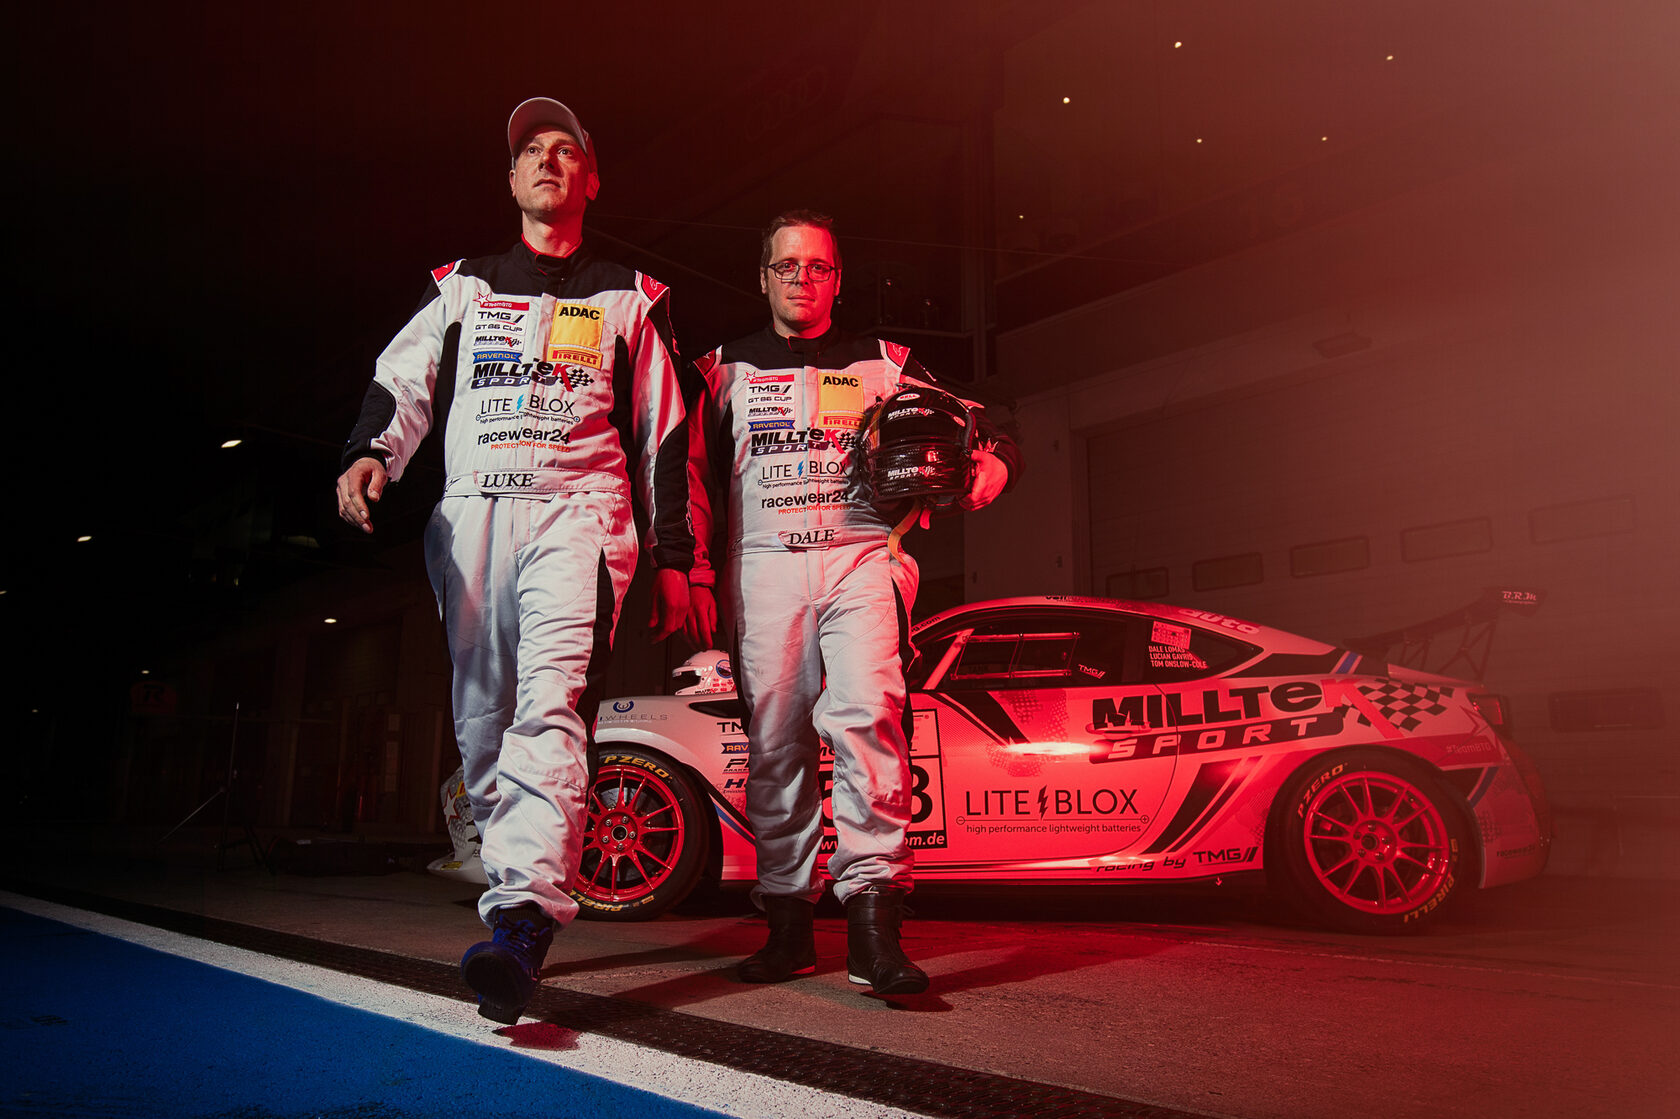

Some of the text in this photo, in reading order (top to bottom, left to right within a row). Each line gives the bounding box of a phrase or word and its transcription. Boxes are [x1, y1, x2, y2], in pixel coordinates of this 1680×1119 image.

[477, 311, 512, 320] TMG
[559, 306, 600, 320] ADAC
[503, 324, 523, 332] CUP
[476, 352, 516, 360] RAVENOL
[552, 349, 598, 365] PIRELLI
[476, 375, 543, 387] SPORT
[822, 376, 859, 387] ADAC
[748, 385, 780, 393] TMG
[480, 394, 575, 416] LITE BLOX
[477, 427, 571, 445] racewear24
[490, 440, 532, 450] PROTECTION
[755, 441, 820, 455] SPORT
[762, 460, 848, 480] LITE BLOX
[482, 473, 533, 488] LUKE
[761, 490, 849, 508] racewear24
[778, 505, 817, 515] PROTECTION
[788, 529, 835, 545] DALE
[717, 722, 743, 732] TM
[1107, 717, 1318, 759] SPORT
[965, 789, 1139, 816] LITE BLOX
[966, 823, 1141, 834] high performance lightweight batteries
[1096, 847, 1243, 872] racing by TMG
